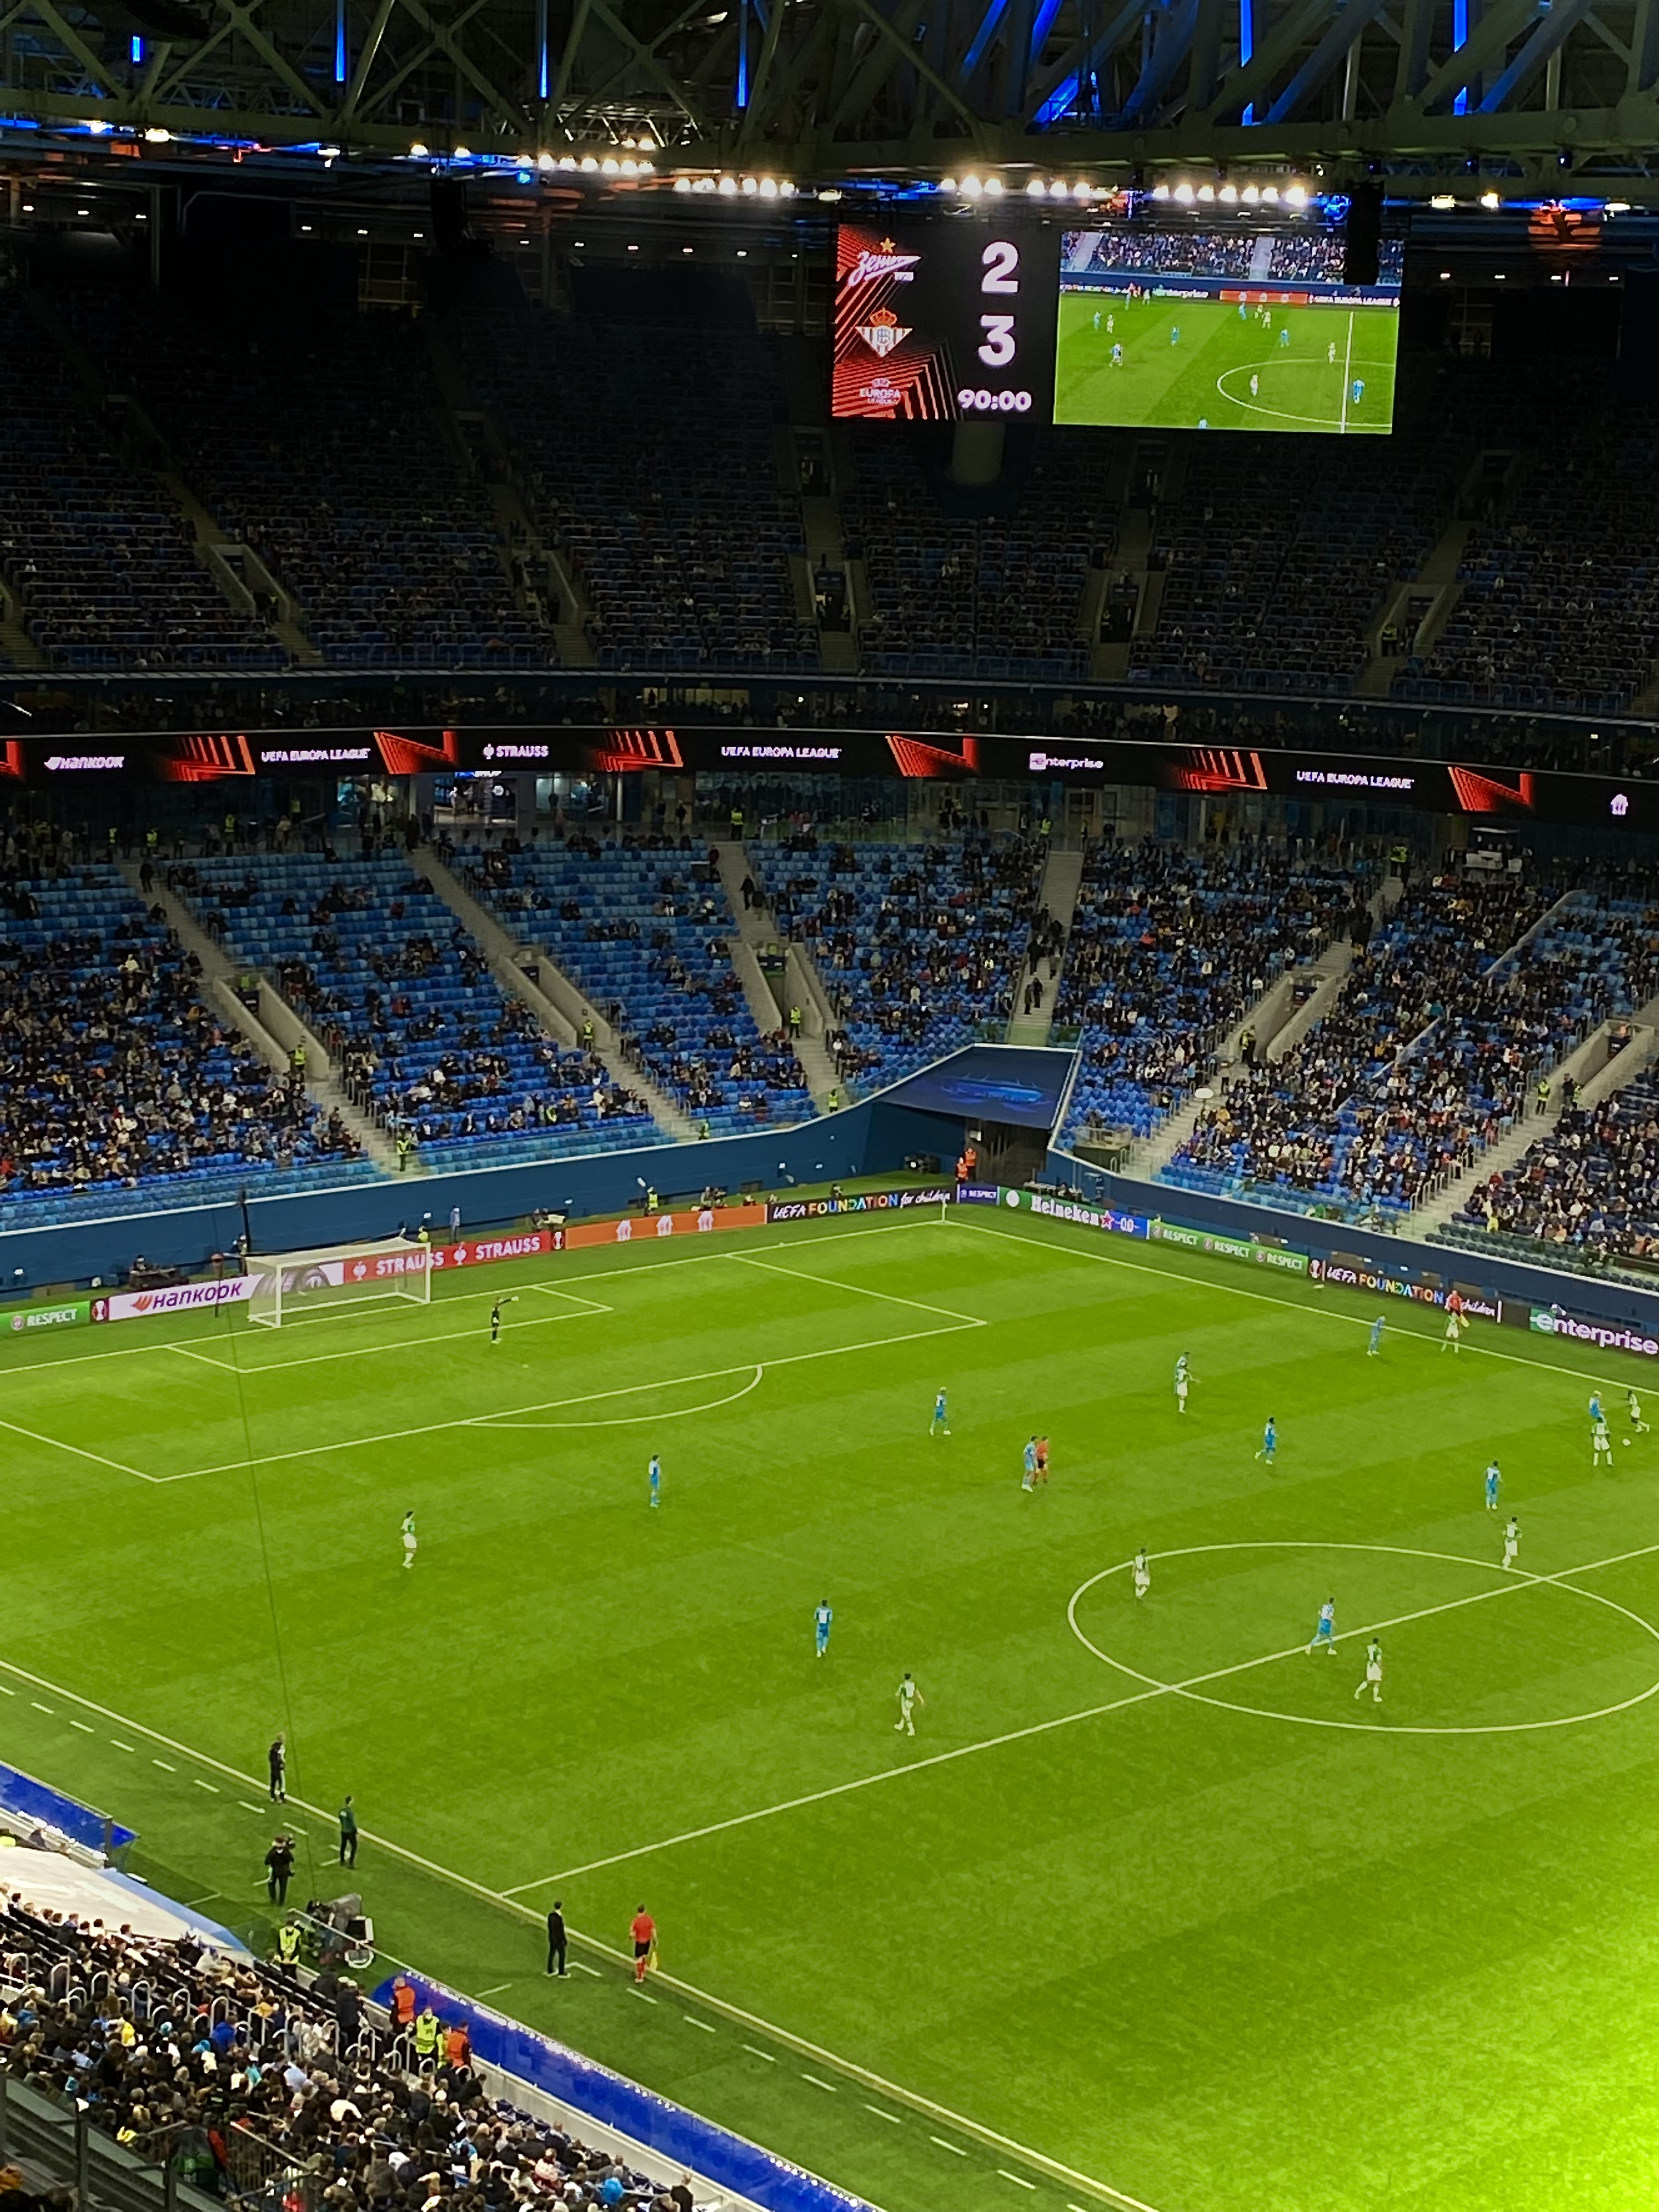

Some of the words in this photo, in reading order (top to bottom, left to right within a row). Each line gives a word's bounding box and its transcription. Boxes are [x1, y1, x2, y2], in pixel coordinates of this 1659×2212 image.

[981, 241, 1018, 294] 2
[978, 315, 1016, 366] 3
[958, 390, 1032, 410] 90:00
[262, 751, 287, 761] UEFA
[290, 750, 328, 760] EUROPA
[330, 748, 371, 760] LEAGUE
[496, 746, 549, 758] STRAUSS
[721, 747, 750, 757] UEFA
[752, 747, 794, 757] EUROPA
[796, 748, 839, 758] LEAGUE
[1296, 771, 1324, 783] UEFA
[1327, 772, 1368, 786] EUROPA
[1370, 775, 1412, 788] LEAGUE
[774, 1204, 806, 1218] UEFA
[808, 1194, 899, 1216] FOUNDATION
[1031, 1195, 1099, 1226] Heineken
[1163, 1229, 1198, 1245] RESPECT
[476, 1235, 540, 1261] STRAUSS
[1215, 1241, 1250, 1257] RESPECT
[376, 1251, 444, 1276] STRAUSS
[1267, 1253, 1303, 1270] RESPECT
[1327, 1266, 1357, 1284] UEFA
[1359, 1273, 1444, 1304] FOUNDATION
[27, 1308, 77, 1327] RESPECT
[1531, 1312, 1658, 1355] enterprise
